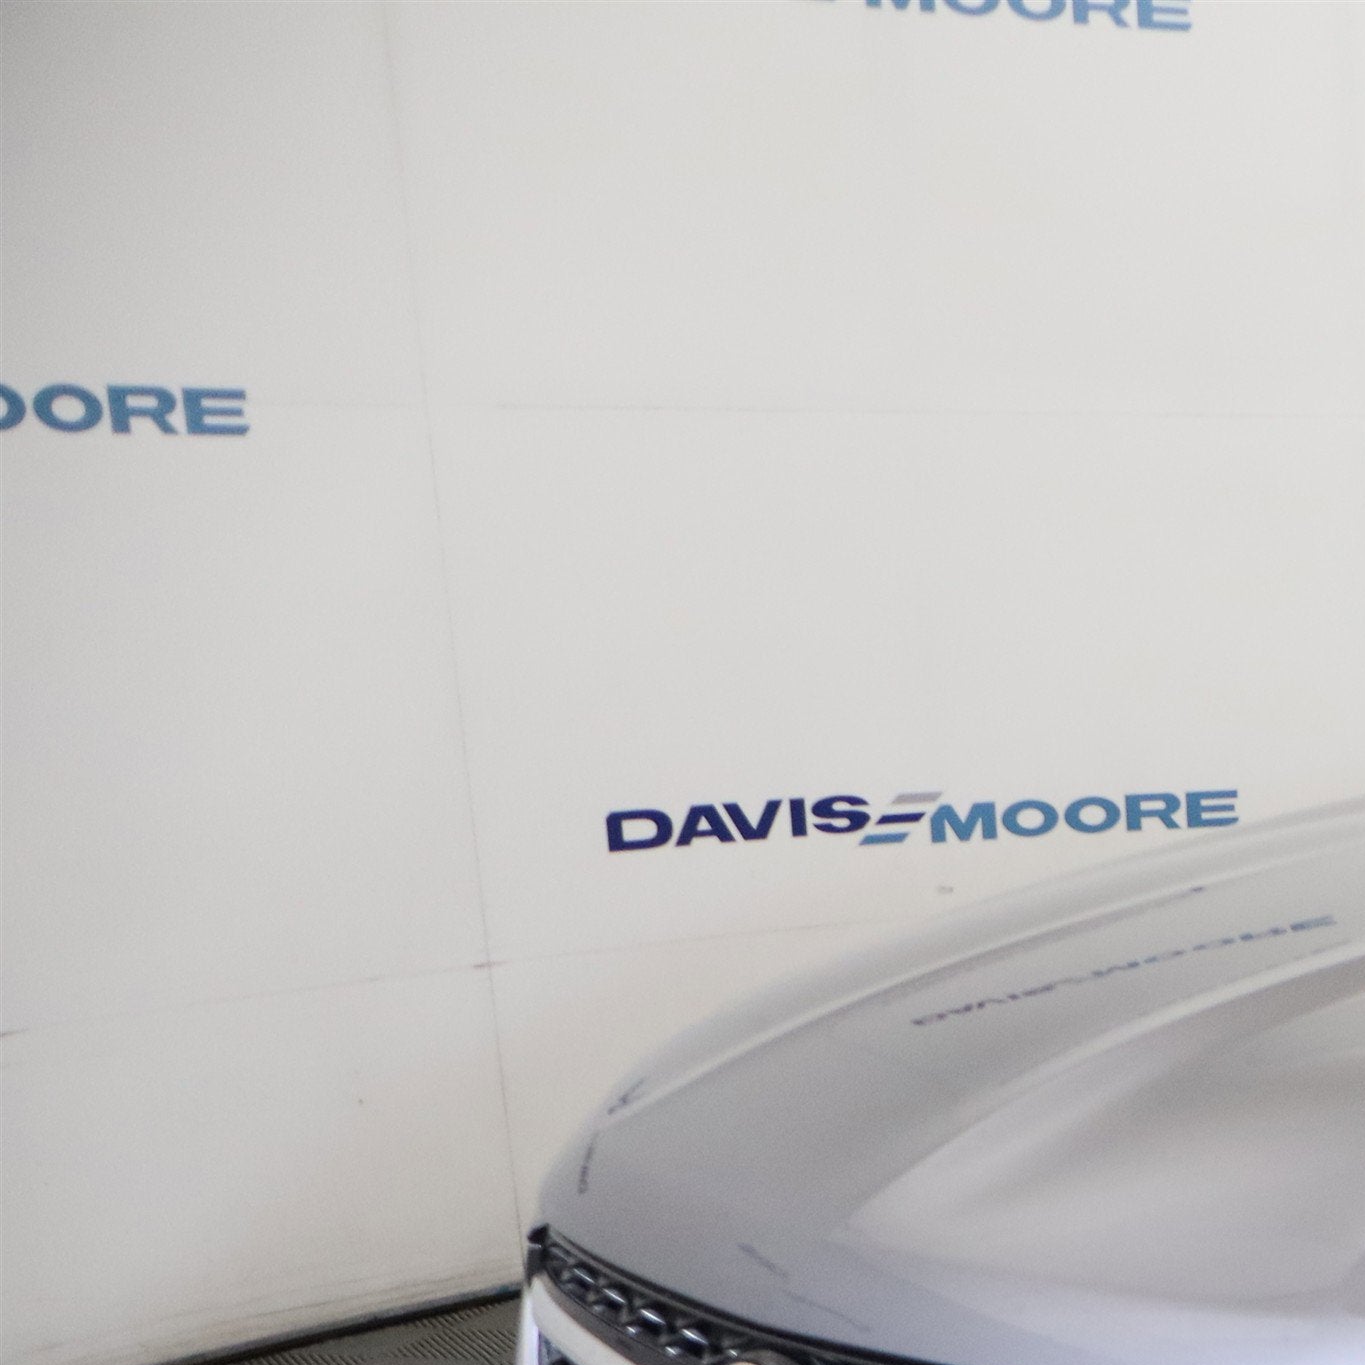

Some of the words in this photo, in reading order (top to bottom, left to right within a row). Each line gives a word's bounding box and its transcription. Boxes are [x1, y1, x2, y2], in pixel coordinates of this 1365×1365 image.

[0, 383, 250, 436] ORE
[604, 795, 871, 852] DAVIS
[930, 789, 1239, 842] MOORE
